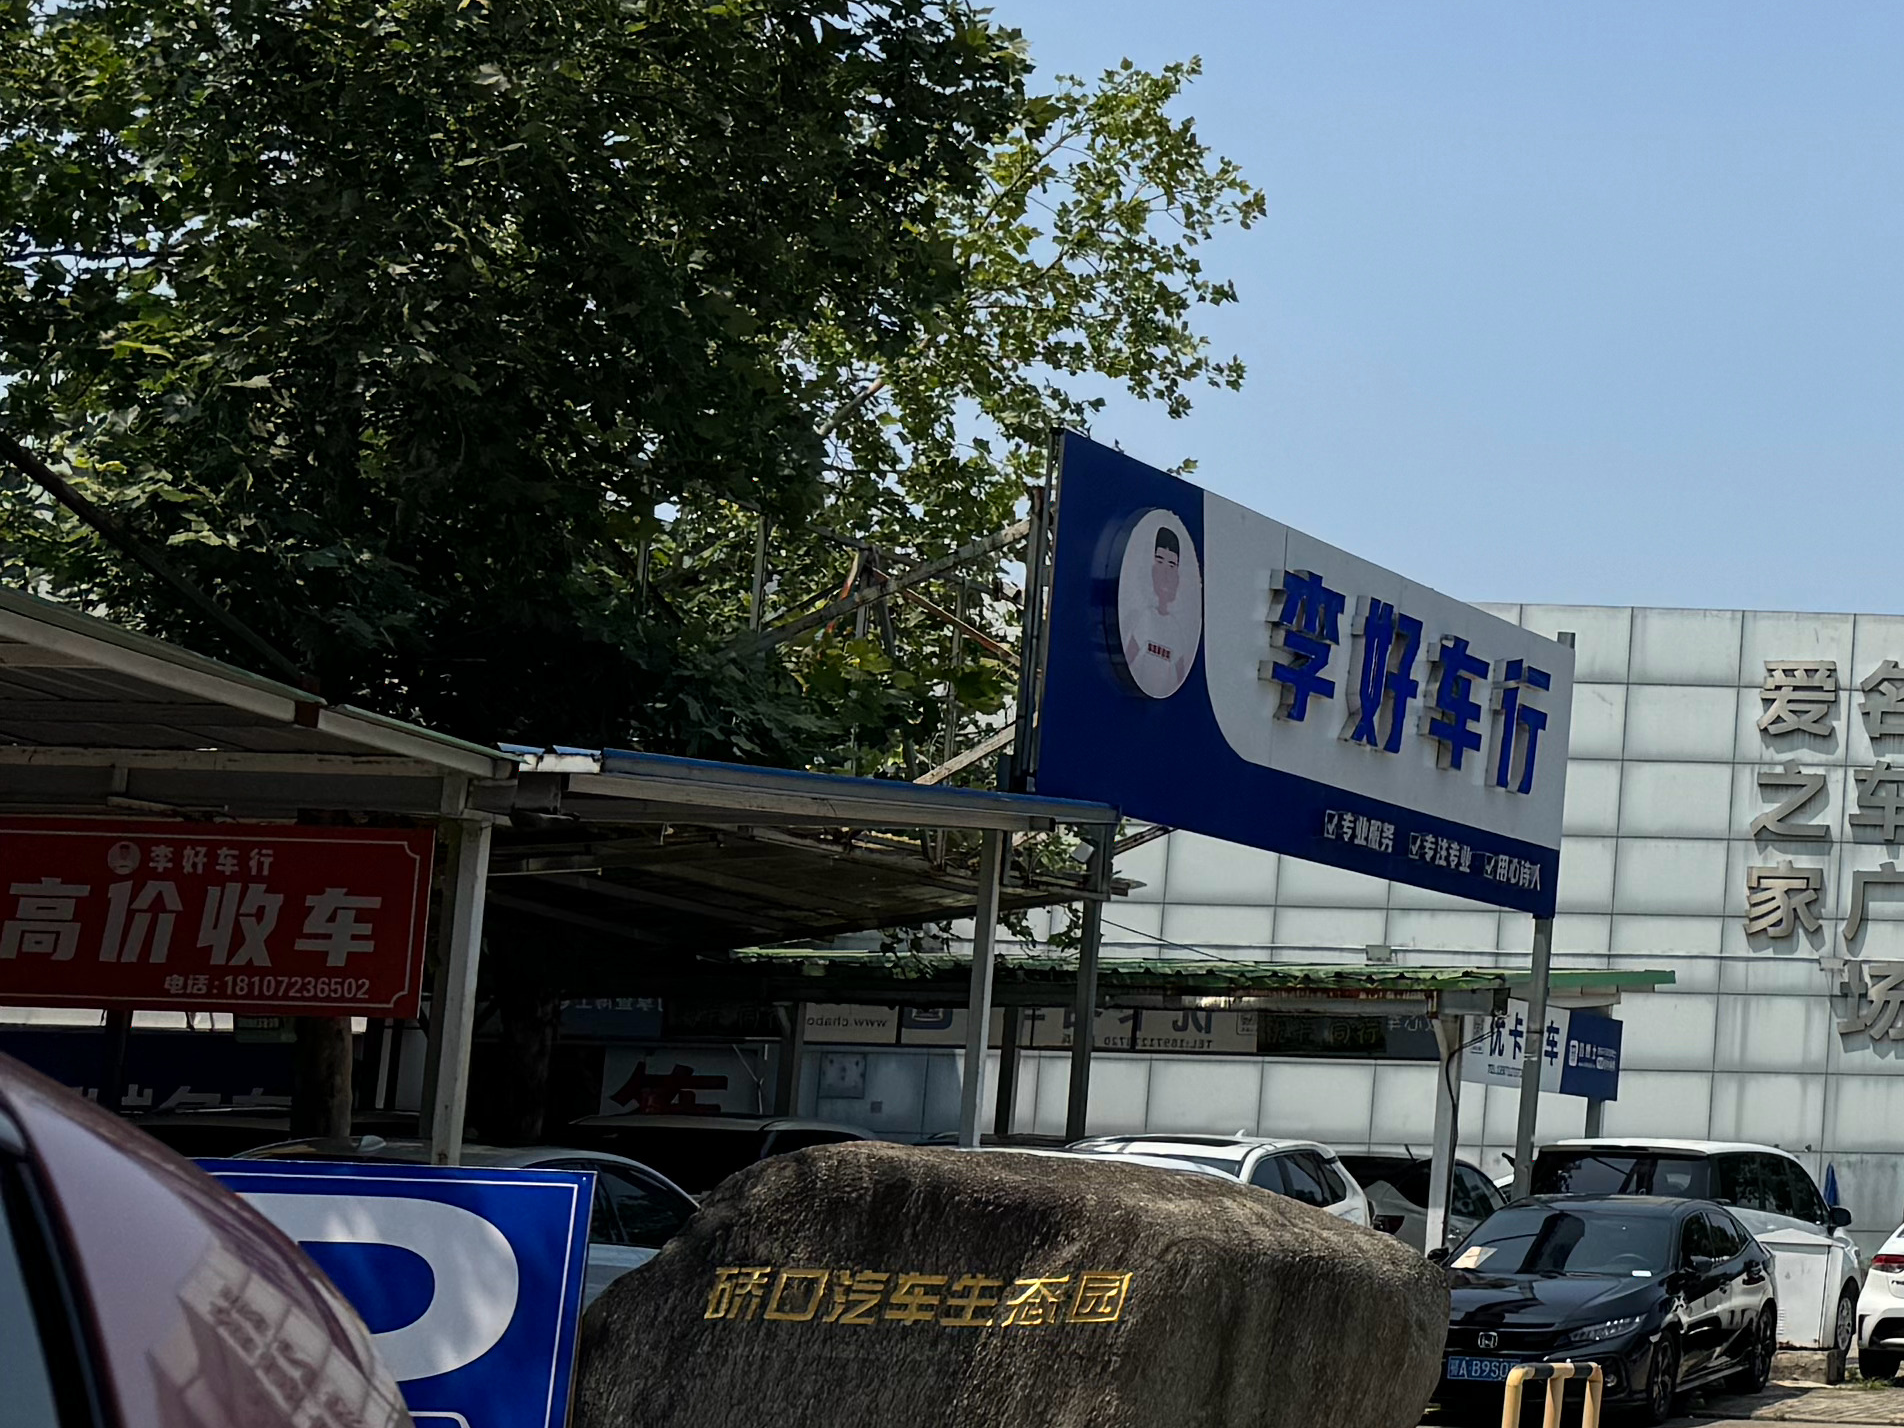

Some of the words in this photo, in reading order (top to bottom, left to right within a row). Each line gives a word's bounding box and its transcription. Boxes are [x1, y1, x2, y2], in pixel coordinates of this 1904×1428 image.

[1260, 570, 1551, 794] 李好车行
[1743, 659, 1838, 939] 爱之家
[149, 845, 274, 876] 李好车行
[1341, 811, 1396, 854] 专业服务
[1, 877, 382, 967] 高价收车
[164, 974, 370, 998] 电话:18107236502
[704, 1266, 1133, 1326] 硚口汽车生态园
